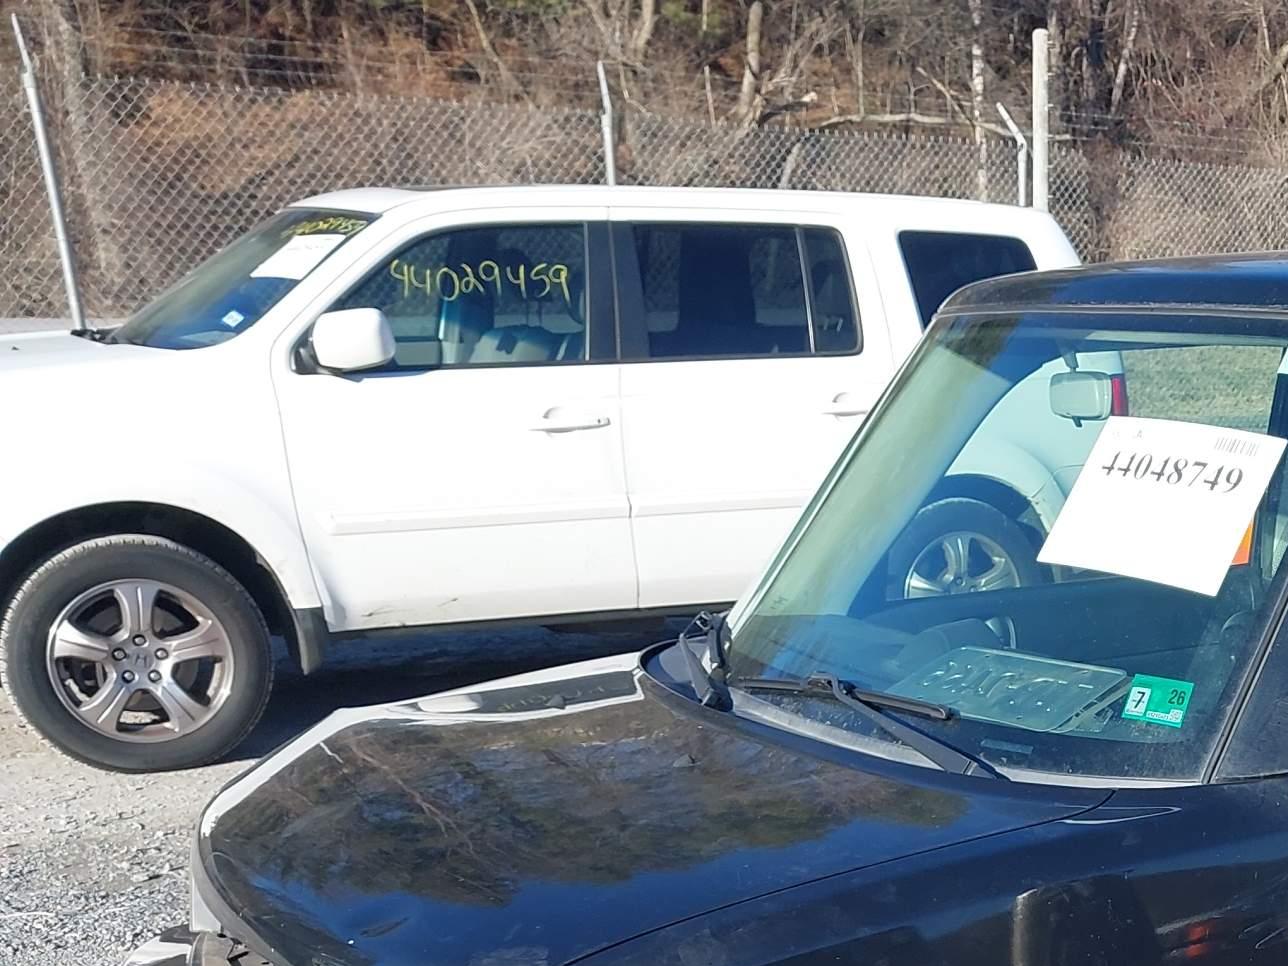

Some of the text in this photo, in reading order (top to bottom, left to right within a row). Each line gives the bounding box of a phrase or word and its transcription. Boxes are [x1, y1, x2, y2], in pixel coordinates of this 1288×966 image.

[390, 259, 571, 302] 44029459
[1102, 451, 1243, 493] 44048749
[1134, 691, 1146, 709] 7
[1167, 689, 1186, 706] 26
